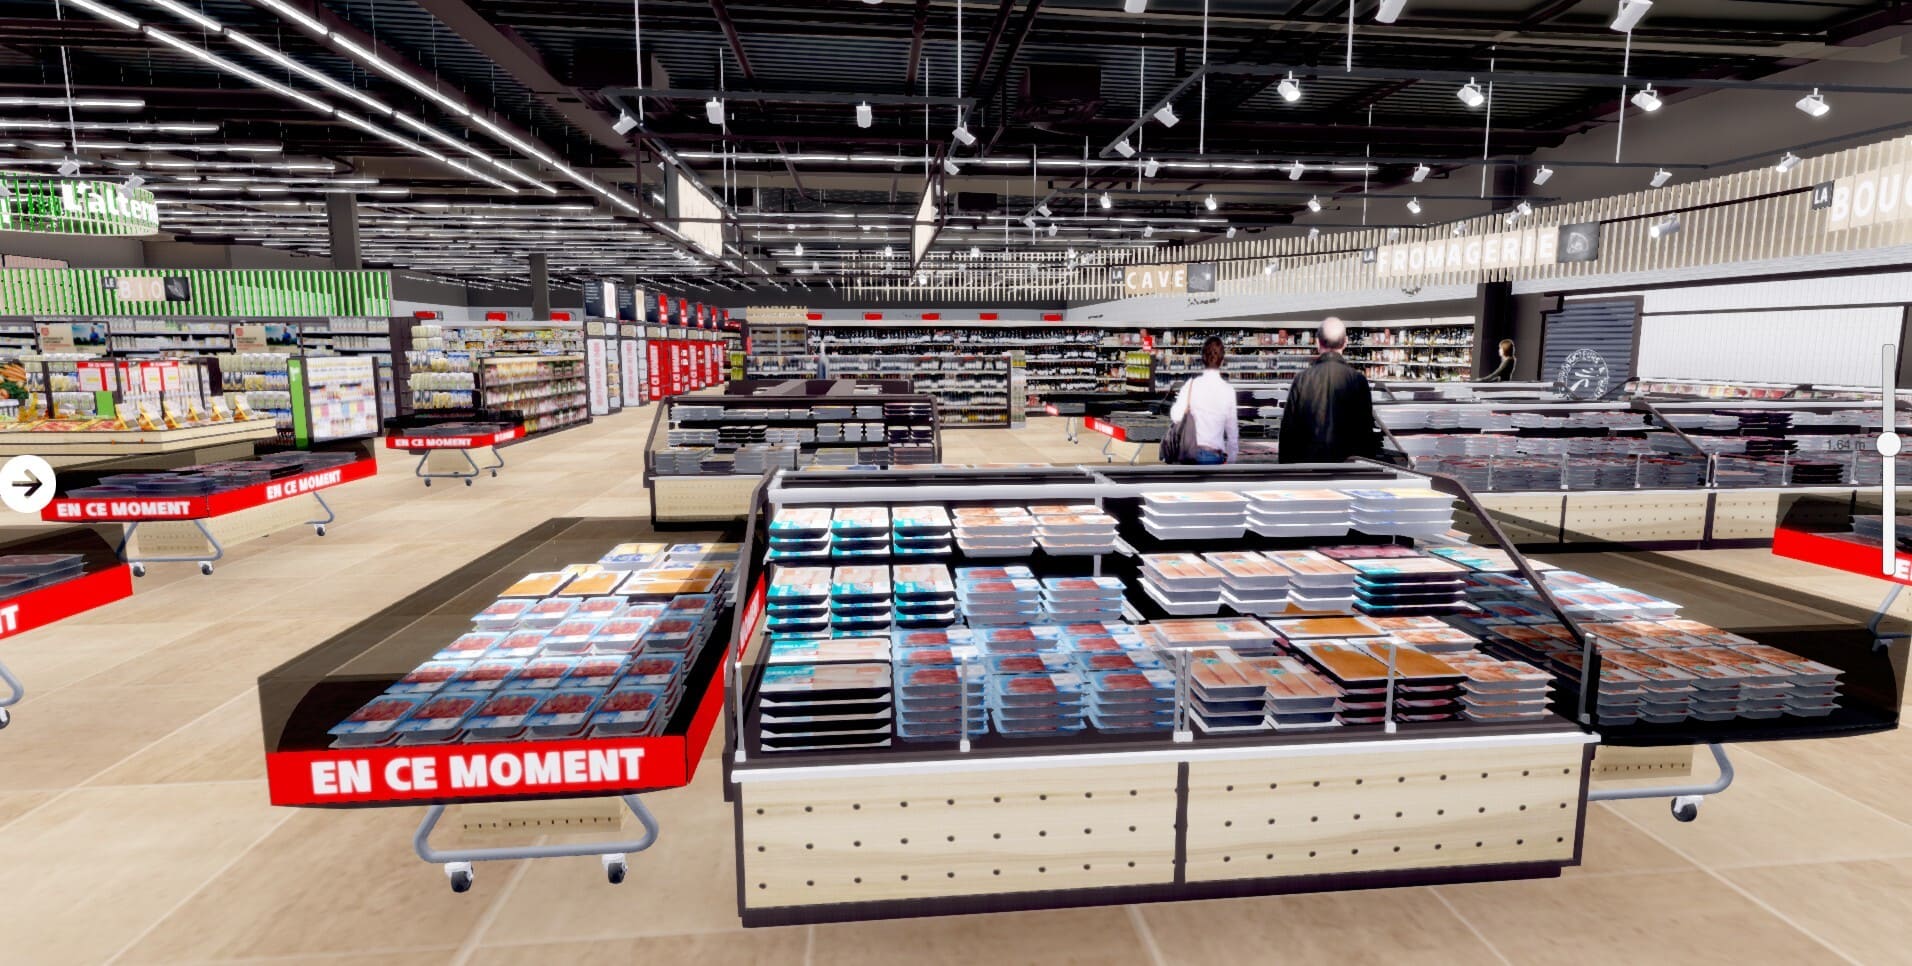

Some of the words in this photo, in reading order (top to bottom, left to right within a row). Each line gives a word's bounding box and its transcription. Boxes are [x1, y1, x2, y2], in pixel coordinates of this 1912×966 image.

[1813, 187, 1828, 205] LA
[1363, 251, 1375, 261] LA
[1378, 233, 1555, 274] FROMAGERIE
[104, 278, 115, 288] LE
[120, 279, 162, 299] BIO
[1112, 270, 1123, 280] LA
[1126, 269, 1185, 290] CAVE
[394, 438, 410, 448] EN
[411, 438, 425, 447] CE
[426, 437, 472, 448] MOMENT
[266, 482, 283, 501] EN
[283, 478, 298, 496] CE
[297, 469, 343, 493] MOMENT
[57, 502, 82, 518] EN
[85, 502, 108, 517] CE
[110, 500, 191, 517] MOMENT
[311, 760, 372, 795] EN
[384, 757, 438, 792] CE
[450, 747, 646, 789] MOMENT
